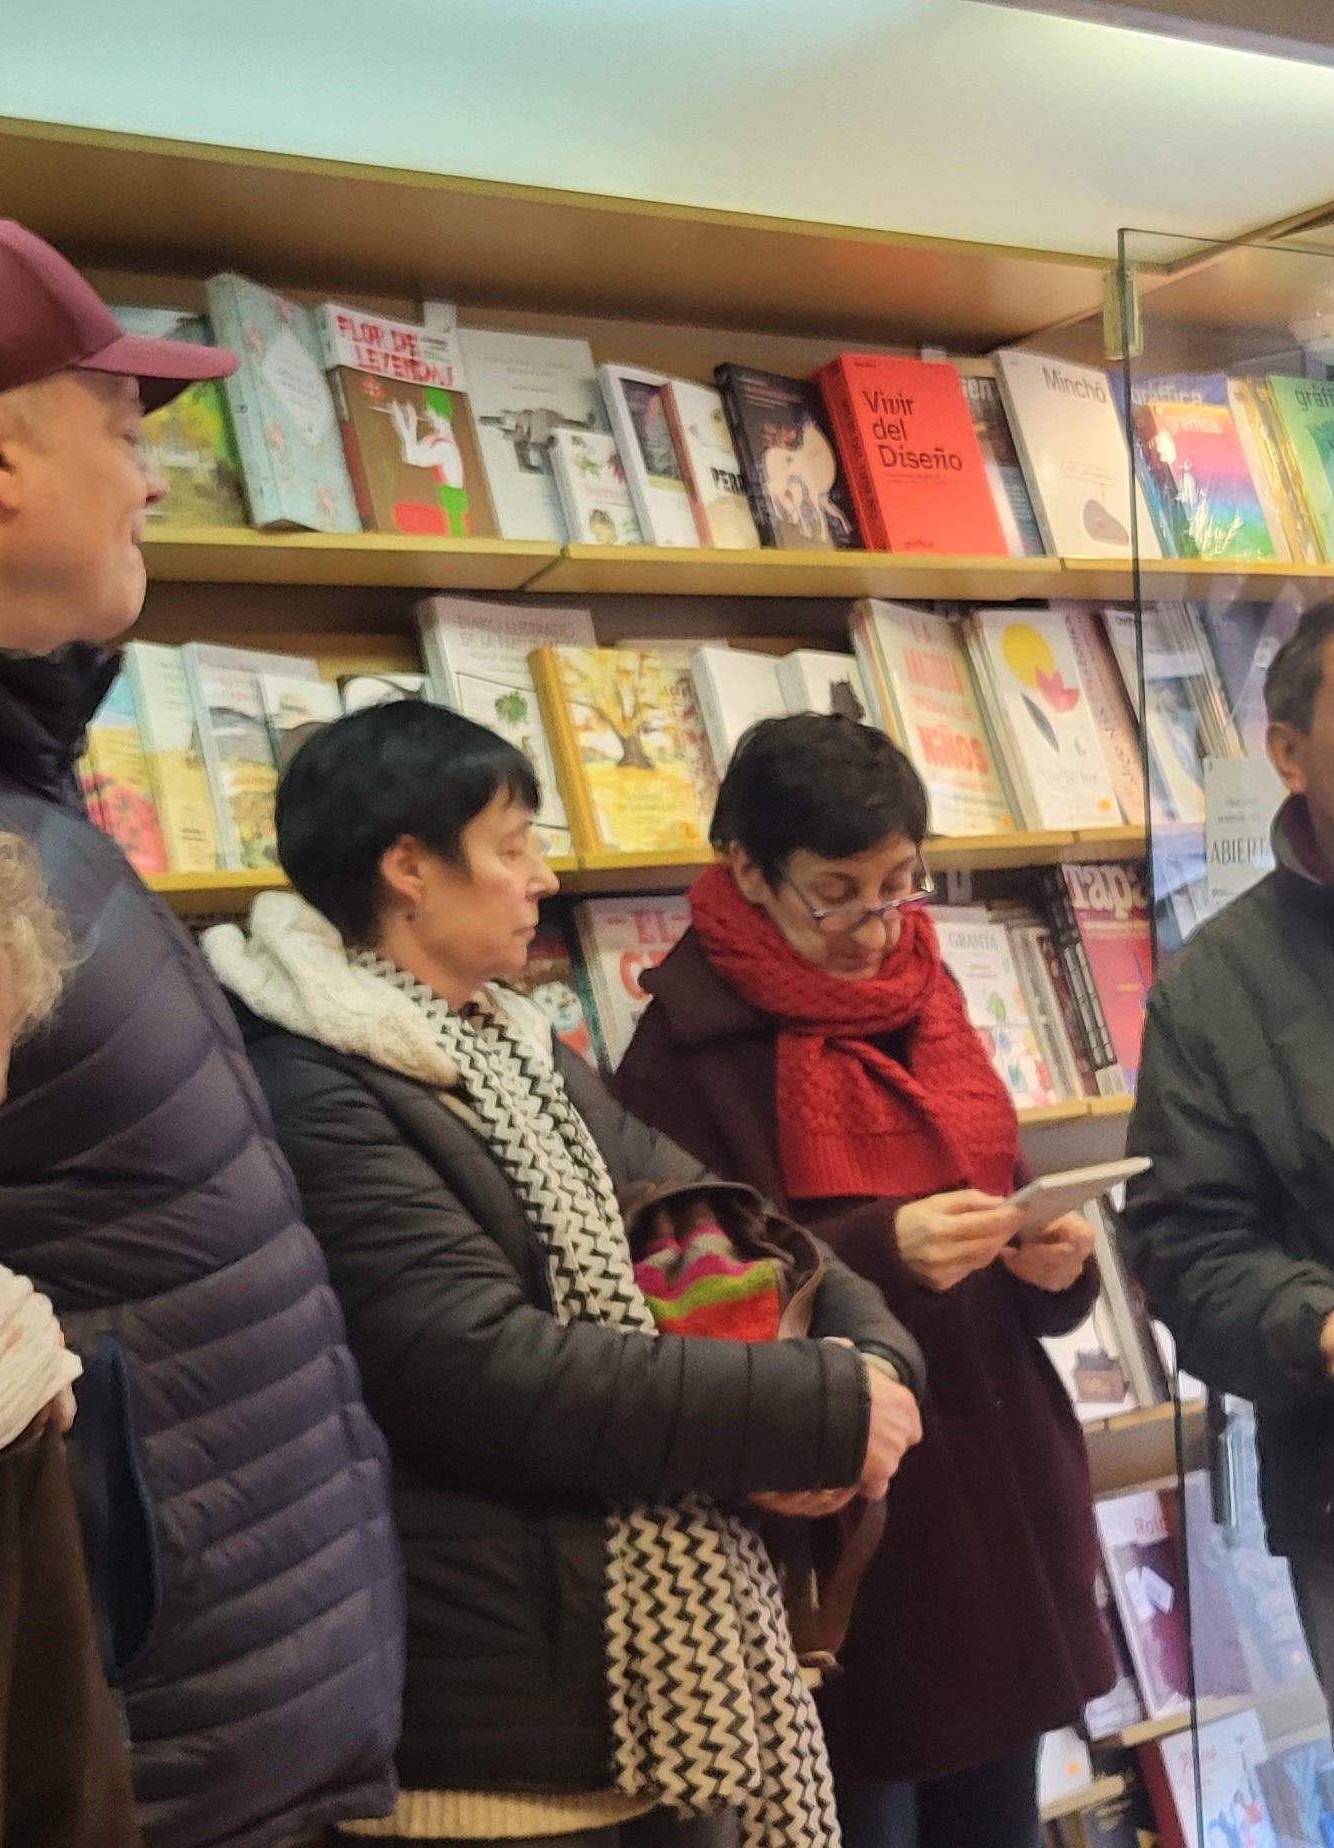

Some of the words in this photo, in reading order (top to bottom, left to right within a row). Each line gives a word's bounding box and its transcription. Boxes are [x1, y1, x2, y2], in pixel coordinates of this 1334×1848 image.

[862, 390, 914, 416] Vivir
[872, 418, 908, 442] del
[878, 444, 963, 472] Diseño
[1210, 836, 1268, 866] ABIERT
